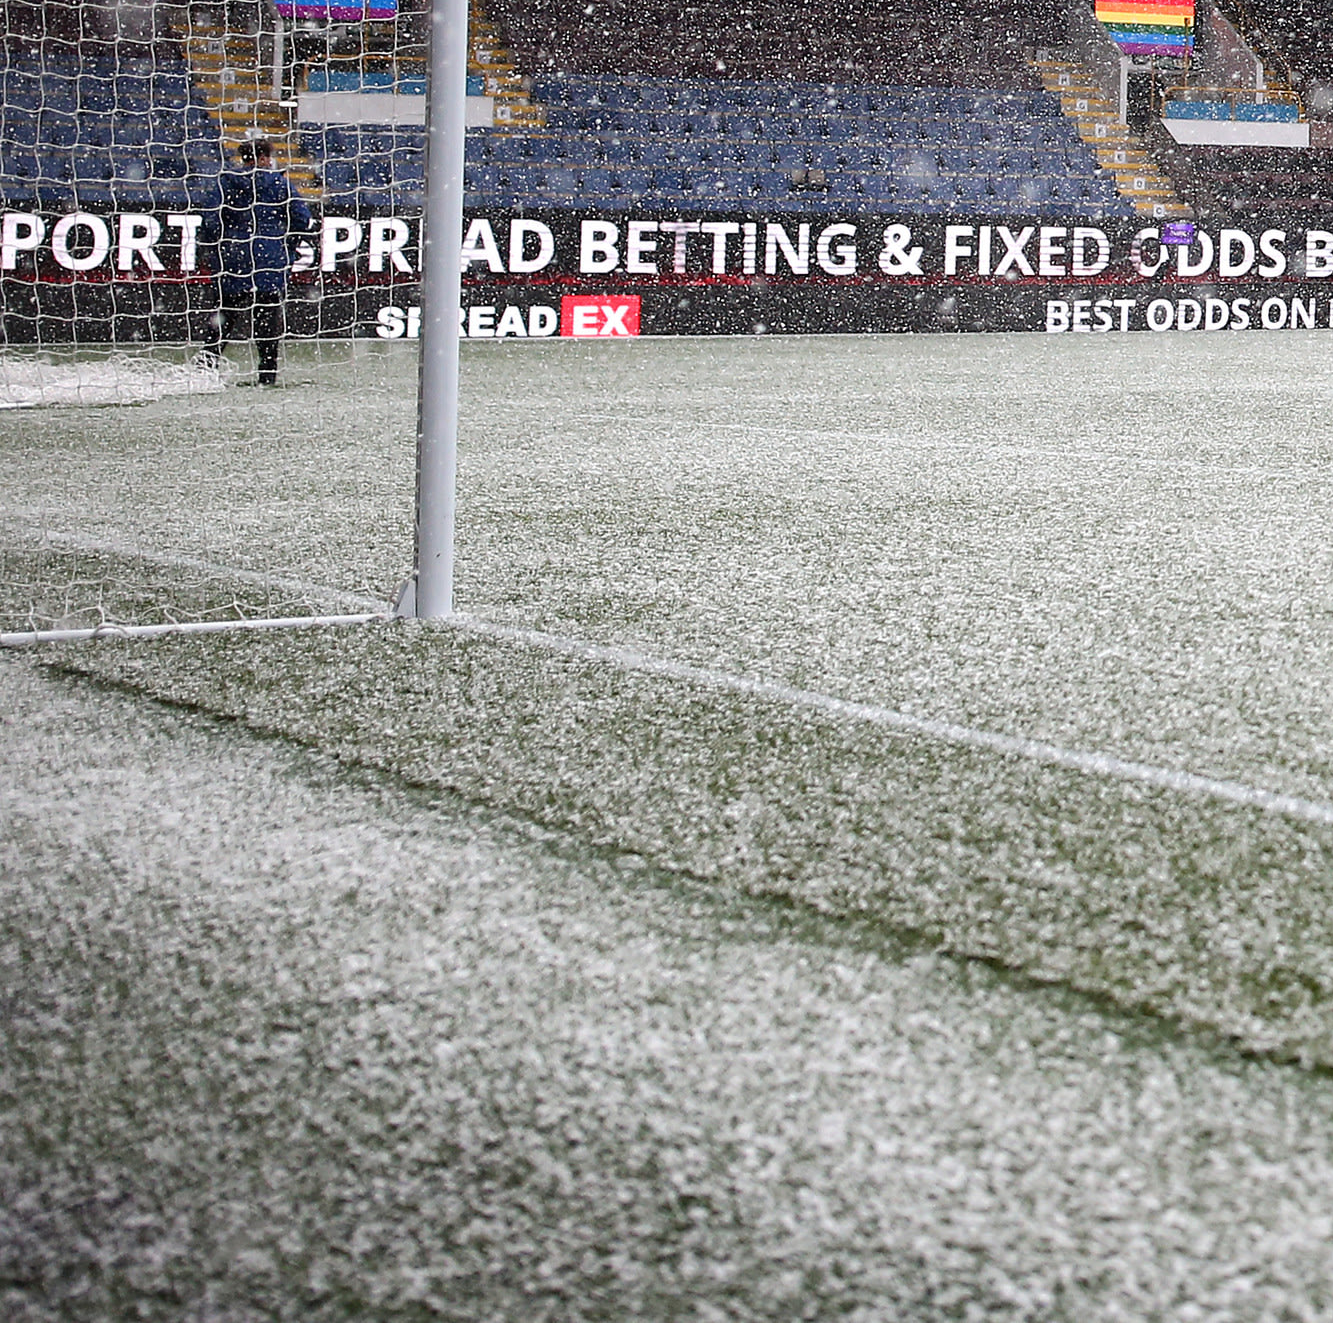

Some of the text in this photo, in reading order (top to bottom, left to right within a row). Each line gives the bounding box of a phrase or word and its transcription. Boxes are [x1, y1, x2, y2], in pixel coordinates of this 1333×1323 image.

[292, 216, 555, 275] PRAD
[579, 220, 857, 275] BETTING
[878, 224, 925, 275] &
[944, 225, 1110, 277] FIXED
[1131, 228, 1287, 278] ODDS
[376, 305, 629, 338] SEAD EX
[1046, 299, 1137, 333] BEST
[1146, 298, 1251, 332] ODDS
[1260, 297, 1317, 331] ON
